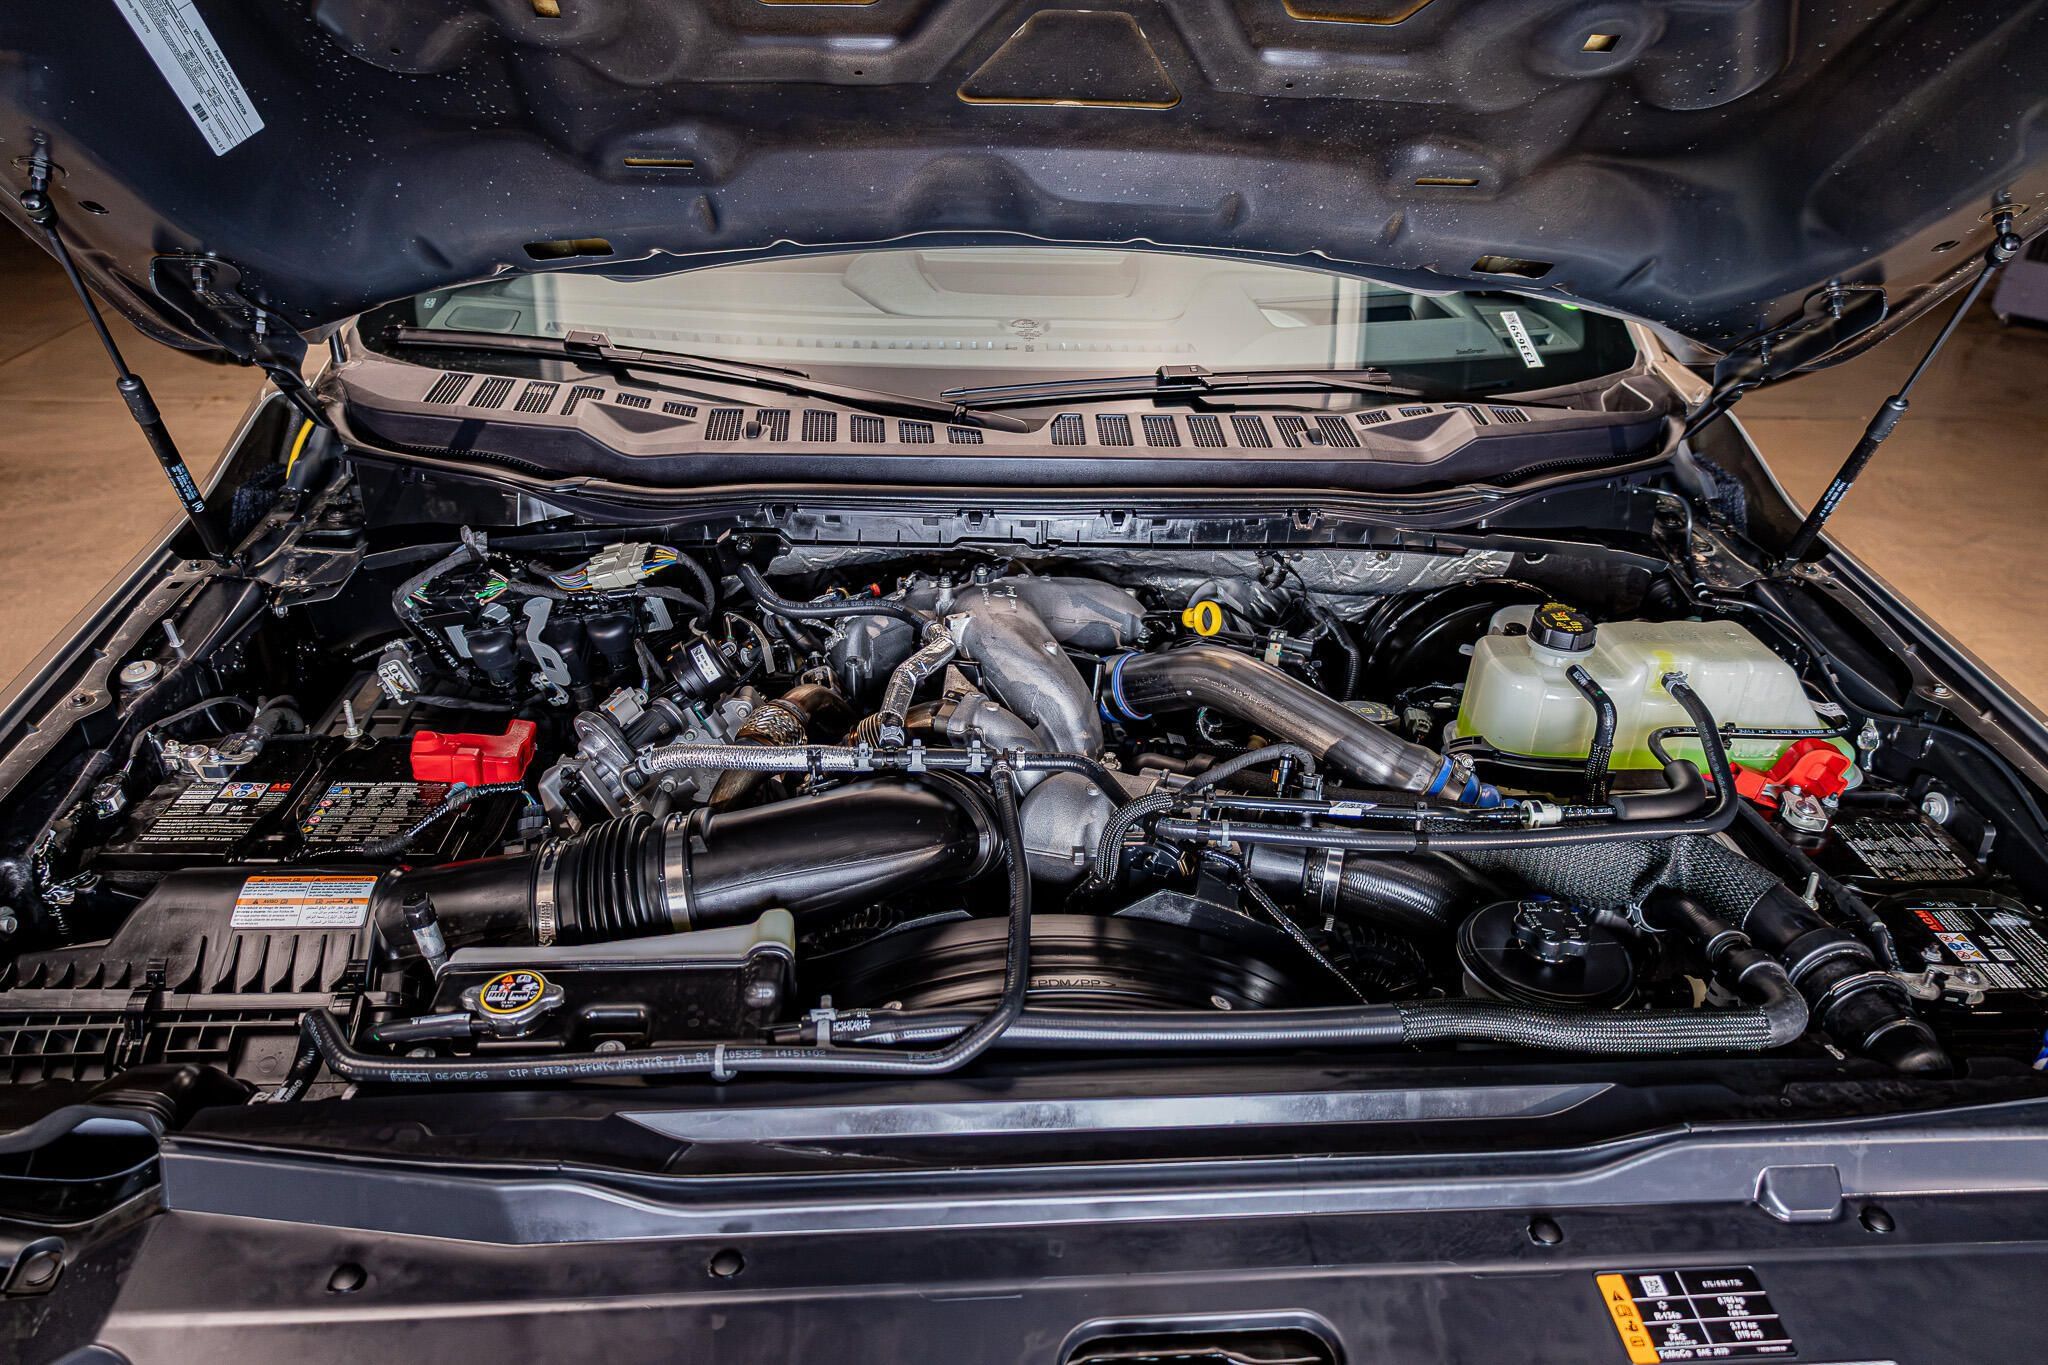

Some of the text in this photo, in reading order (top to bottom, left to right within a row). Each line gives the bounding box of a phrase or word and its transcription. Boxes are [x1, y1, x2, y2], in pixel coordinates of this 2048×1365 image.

[192, 28, 247, 115] VEHICLE EMISSION CONTROL INFORMATION
[213, 49, 240, 90] Ford Motor Company
[1509, 324, 1536, 366] T33659
[435, 1070, 488, 1080] 06/05/26
[508, 1068, 528, 1078] CIP
[1654, 1311, 1682, 1320] R-134a
[1668, 1333, 1687, 1341] PAG
[1659, 1348, 1692, 1359] FoMoCo
[1696, 1348, 1712, 1357] SAE
